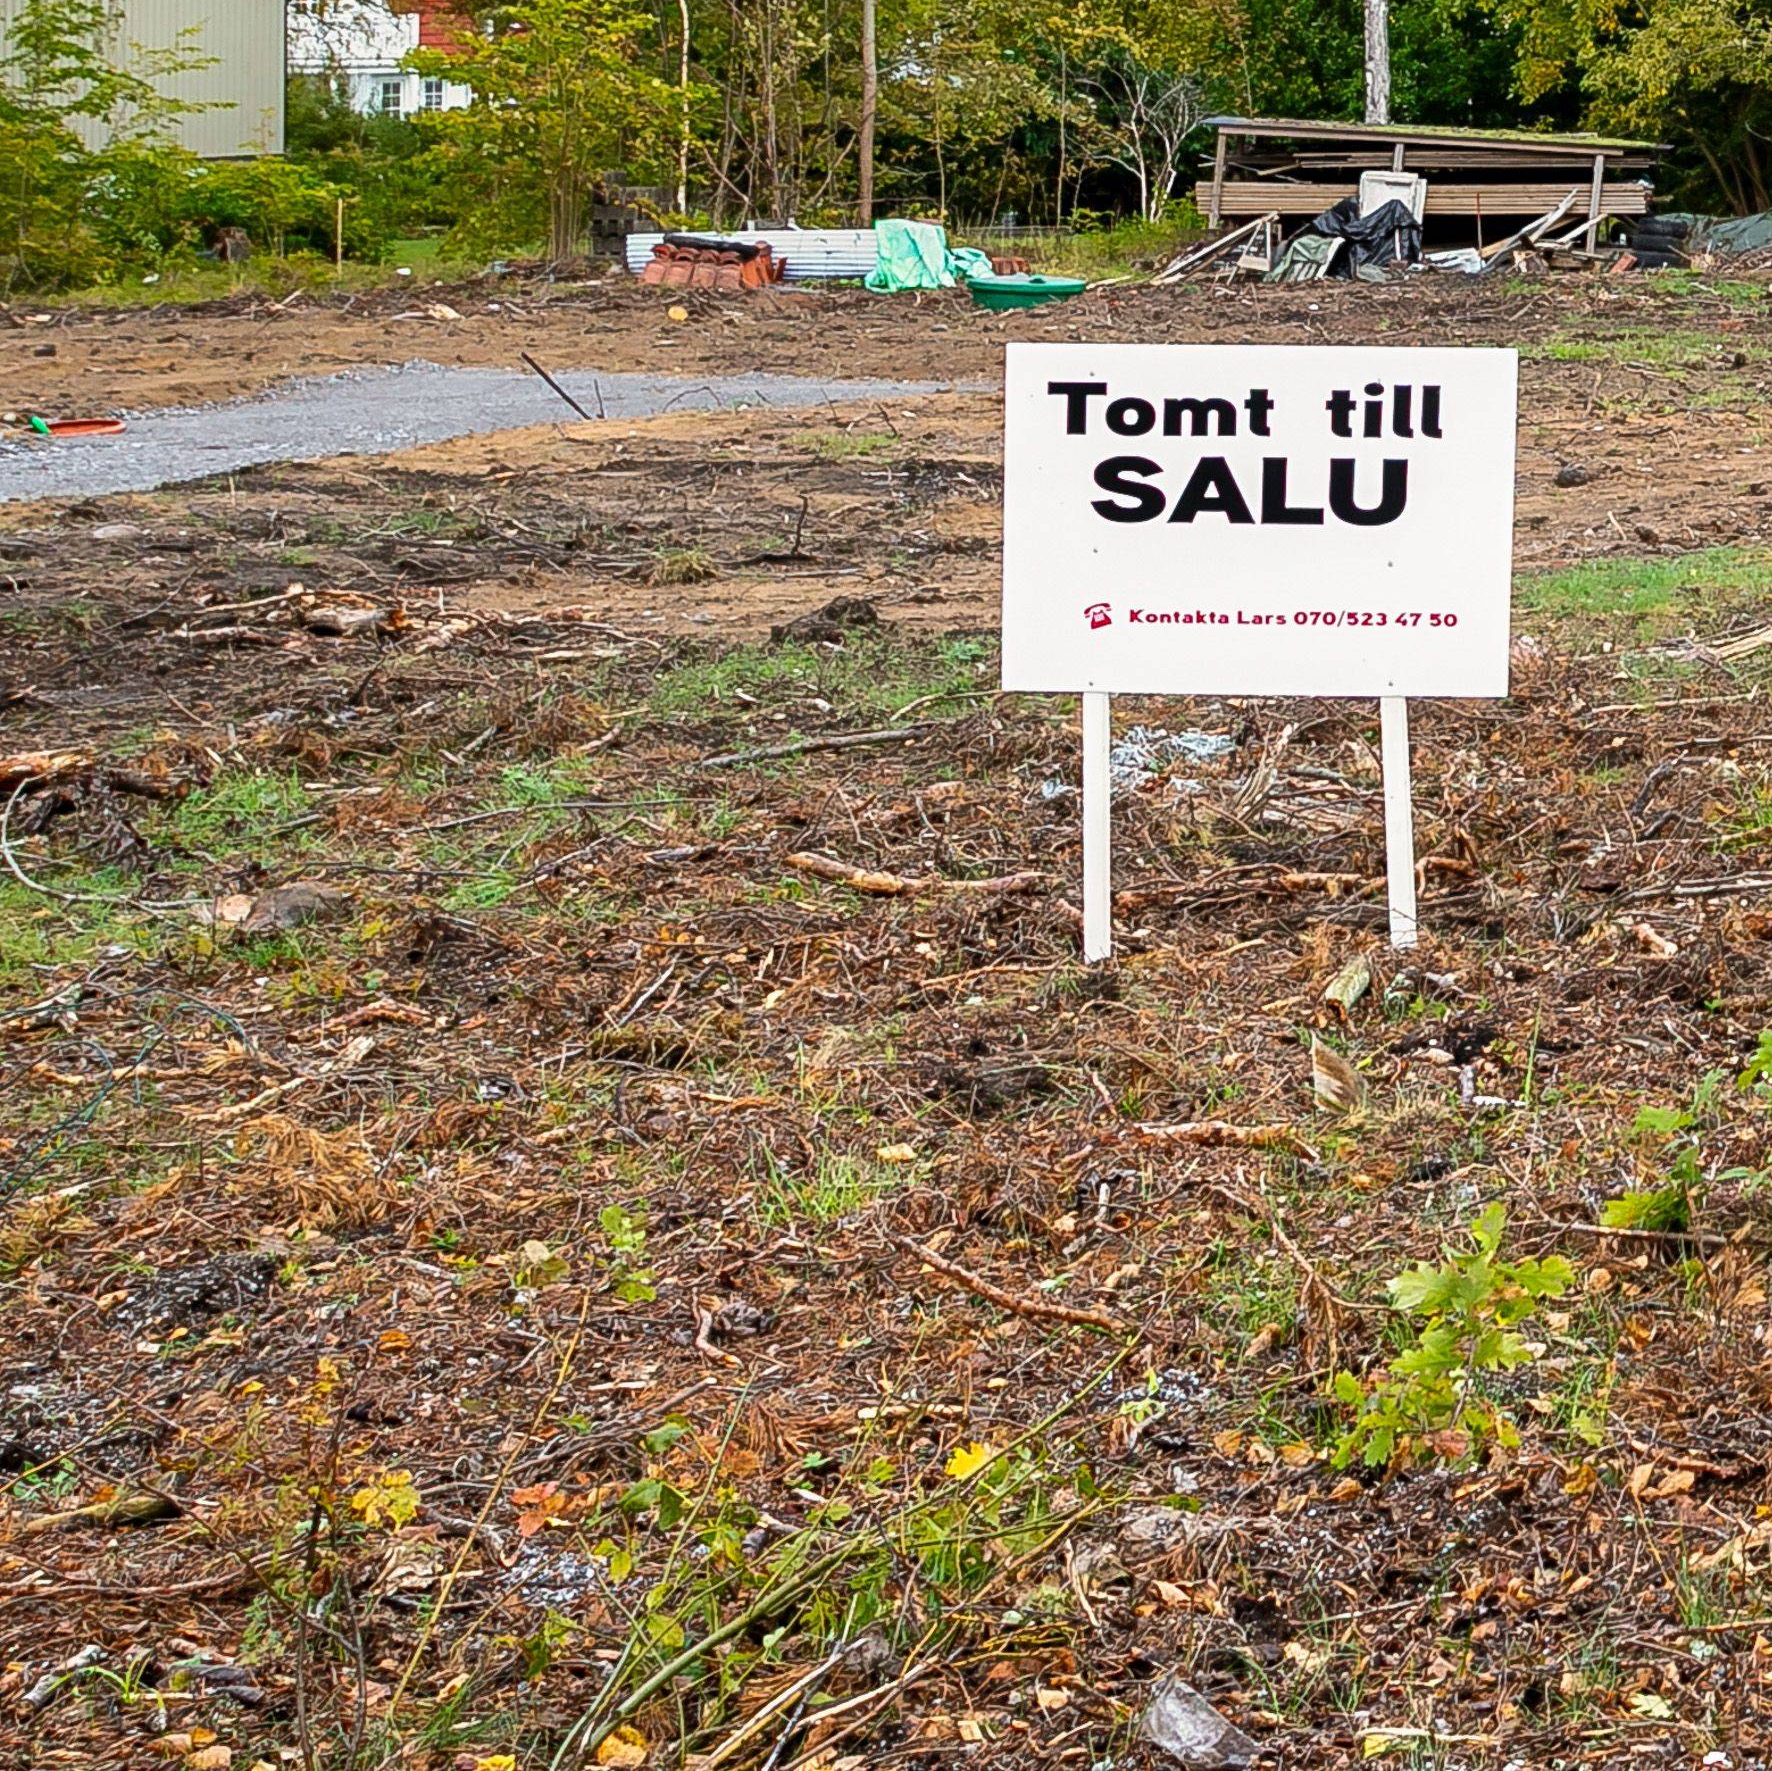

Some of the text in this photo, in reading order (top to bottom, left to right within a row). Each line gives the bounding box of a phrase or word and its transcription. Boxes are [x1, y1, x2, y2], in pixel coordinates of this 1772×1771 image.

[1047, 381, 1443, 439] Tomt till
[1090, 455, 1409, 526] SALU
[1129, 609, 1458, 628] Kontakta Lars 070/523 47 50
